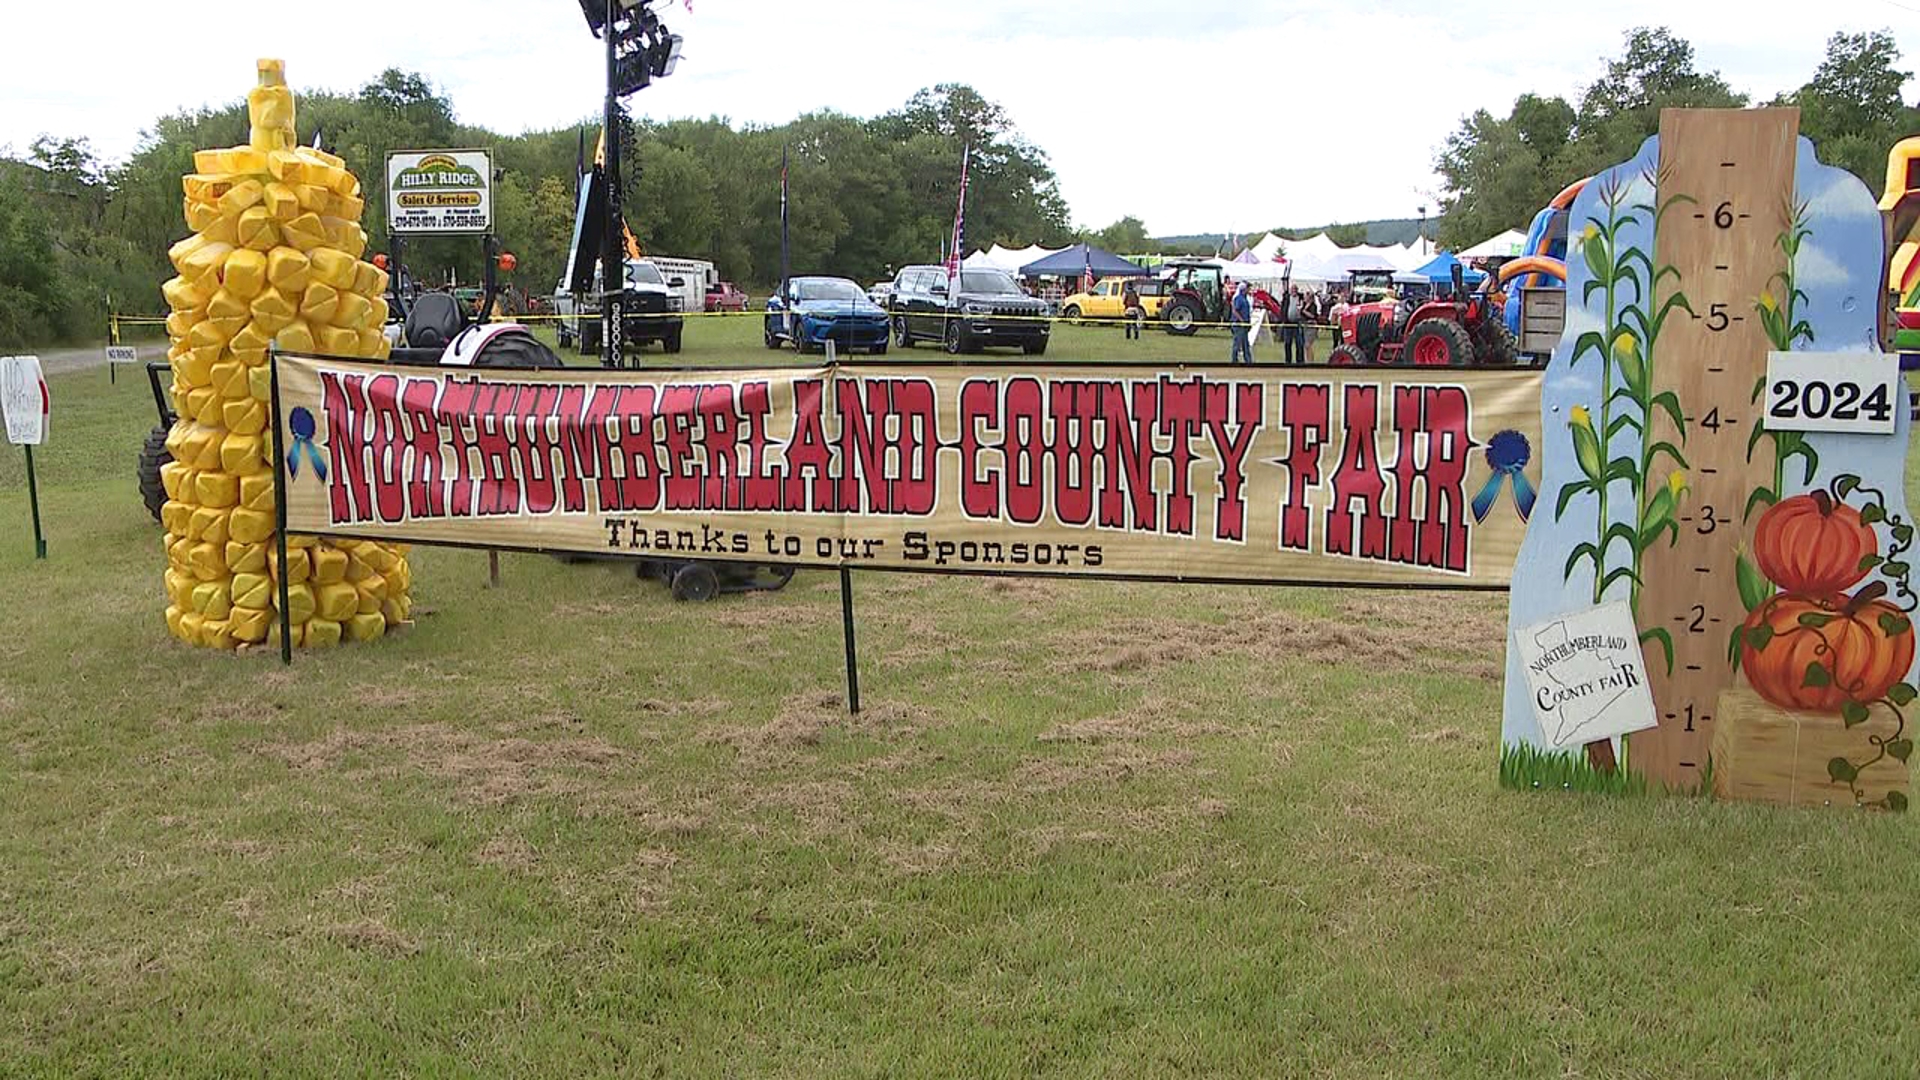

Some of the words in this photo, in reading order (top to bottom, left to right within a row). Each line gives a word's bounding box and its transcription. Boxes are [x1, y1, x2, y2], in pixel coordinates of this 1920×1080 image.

[401, 172, 436, 187] HILLY
[439, 171, 477, 185] RIDGE
[402, 195, 424, 205] Sales
[437, 194, 469, 204] Service
[1714, 201, 1734, 229] 6
[1705, 304, 1729, 331] 5
[1770, 380, 1892, 421] 2024
[1700, 407, 1721, 434] 4
[319, 372, 938, 525] NORTHUMBERLAND
[959, 374, 1265, 543] COUNTY
[1279, 383, 1471, 573] FAIR
[1696, 505, 1716, 534] 3
[604, 518, 749, 554] Thanks
[765, 527, 801, 556] to
[816, 535, 884, 560] our
[903, 531, 1104, 566] Sponsors
[1689, 605, 1705, 633] 2
[1529, 634, 1628, 676] NORTHUMBERLAND
[1536, 680, 1594, 711] COUNTY
[1683, 704, 1695, 732] 1
